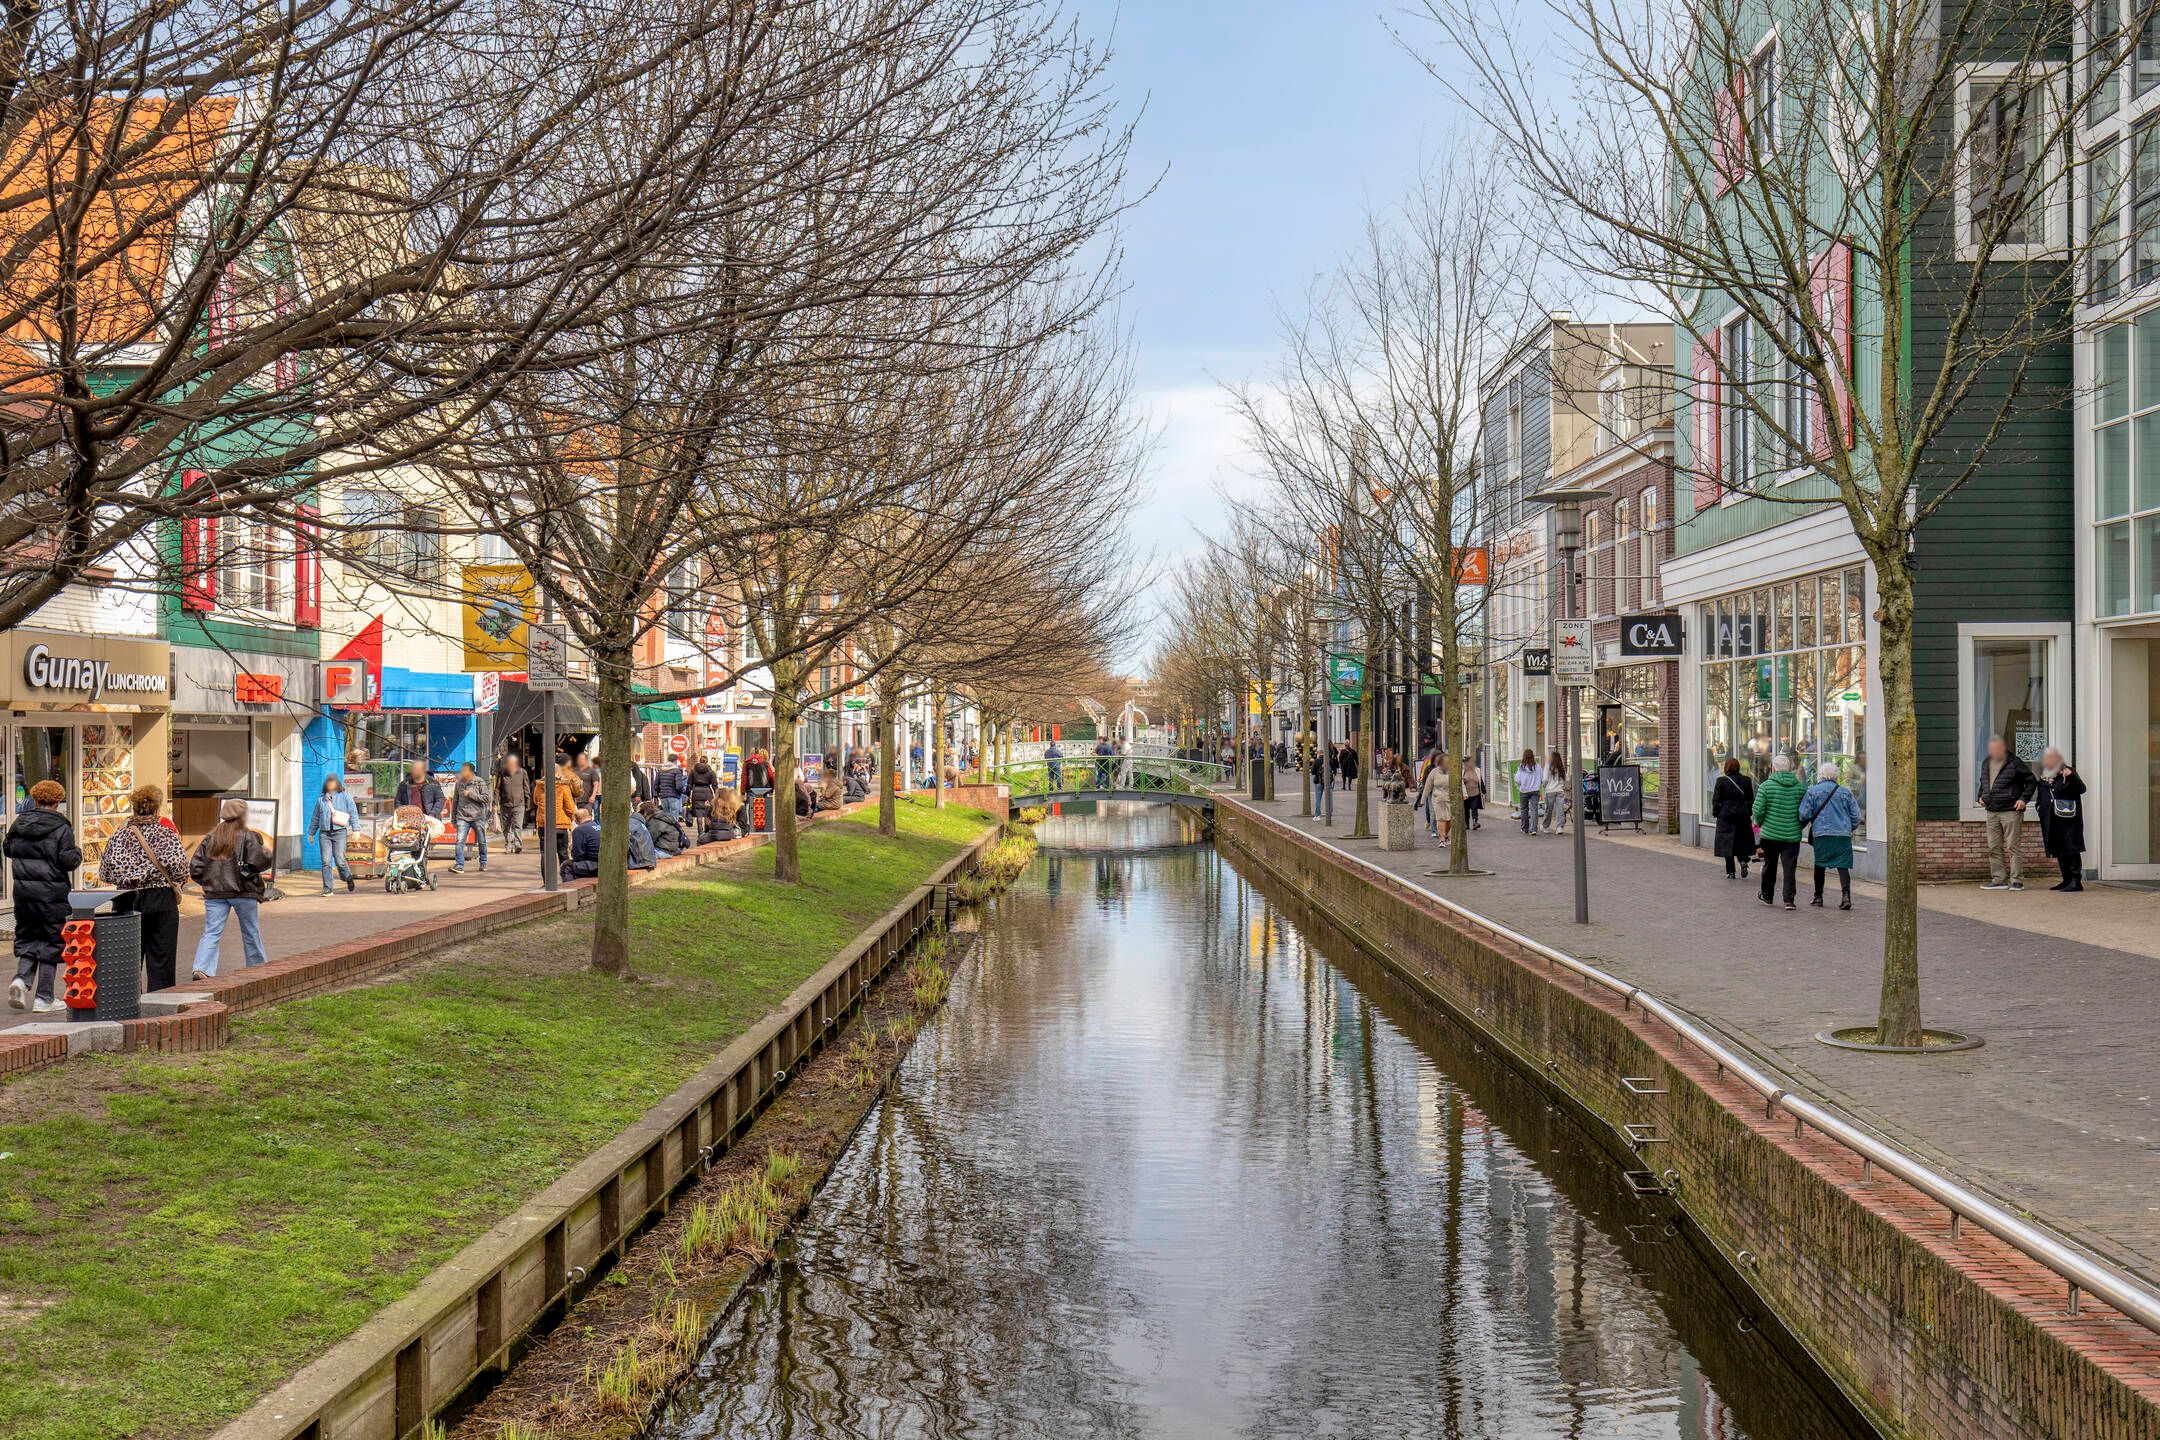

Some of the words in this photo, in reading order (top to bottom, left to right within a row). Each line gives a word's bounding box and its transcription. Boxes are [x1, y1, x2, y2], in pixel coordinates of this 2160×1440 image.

[1629, 623, 1675, 648] C&A
[26, 643, 110, 700] Gunay
[107, 672, 166, 692] LUNCHROOM
[326, 666, 355, 698] F
[1391, 685, 1406, 693] WE
